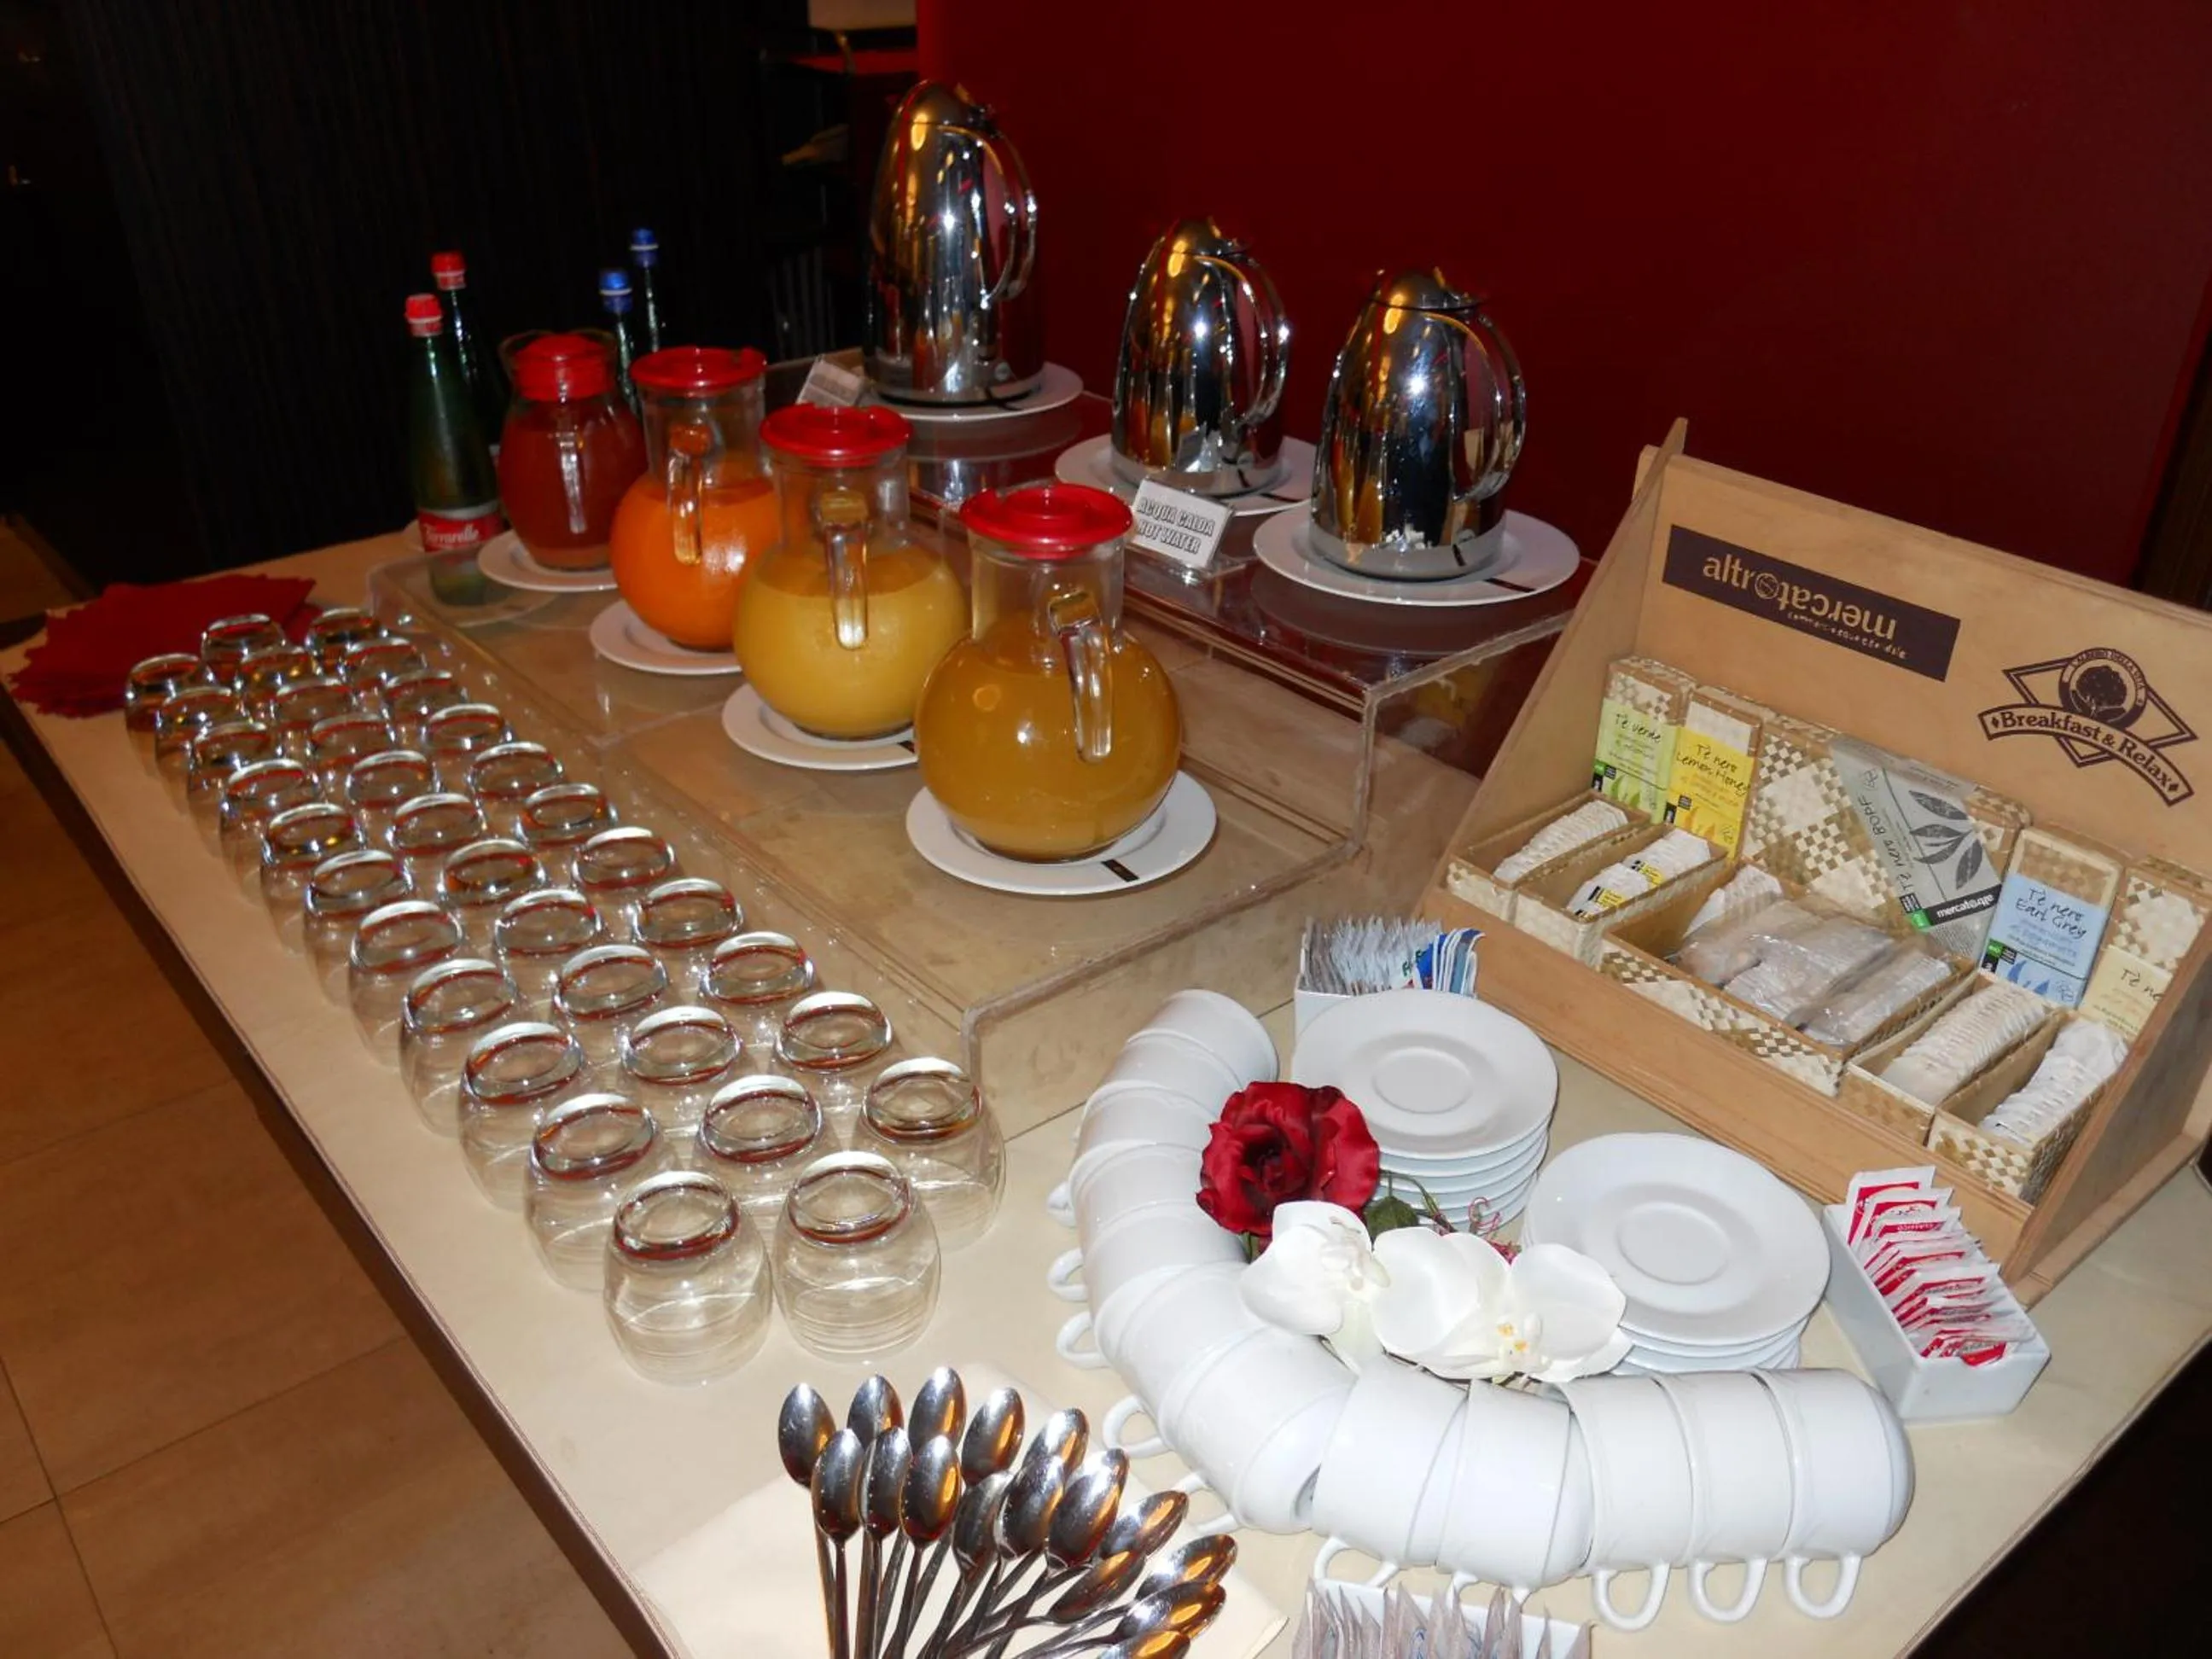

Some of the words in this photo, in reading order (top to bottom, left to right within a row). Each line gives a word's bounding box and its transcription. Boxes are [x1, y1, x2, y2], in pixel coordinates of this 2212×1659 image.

[1136, 497, 1177, 524] ACQUA
[1178, 510, 1215, 537] CALDA
[1138, 519, 1161, 540] HOT
[1161, 528, 1202, 555] WATER
[1631, 723, 1661, 742] verde
[2000, 711, 2103, 742] Breakfast
[2102, 733, 2116, 748] &
[2118, 737, 2172, 788] Relax
[1714, 755, 1737, 773] nero
[2016, 897, 2047, 922] Earl
[2052, 915, 2087, 940] Grey
[2050, 901, 2085, 922] nero
[2144, 986, 2165, 1001] ne
